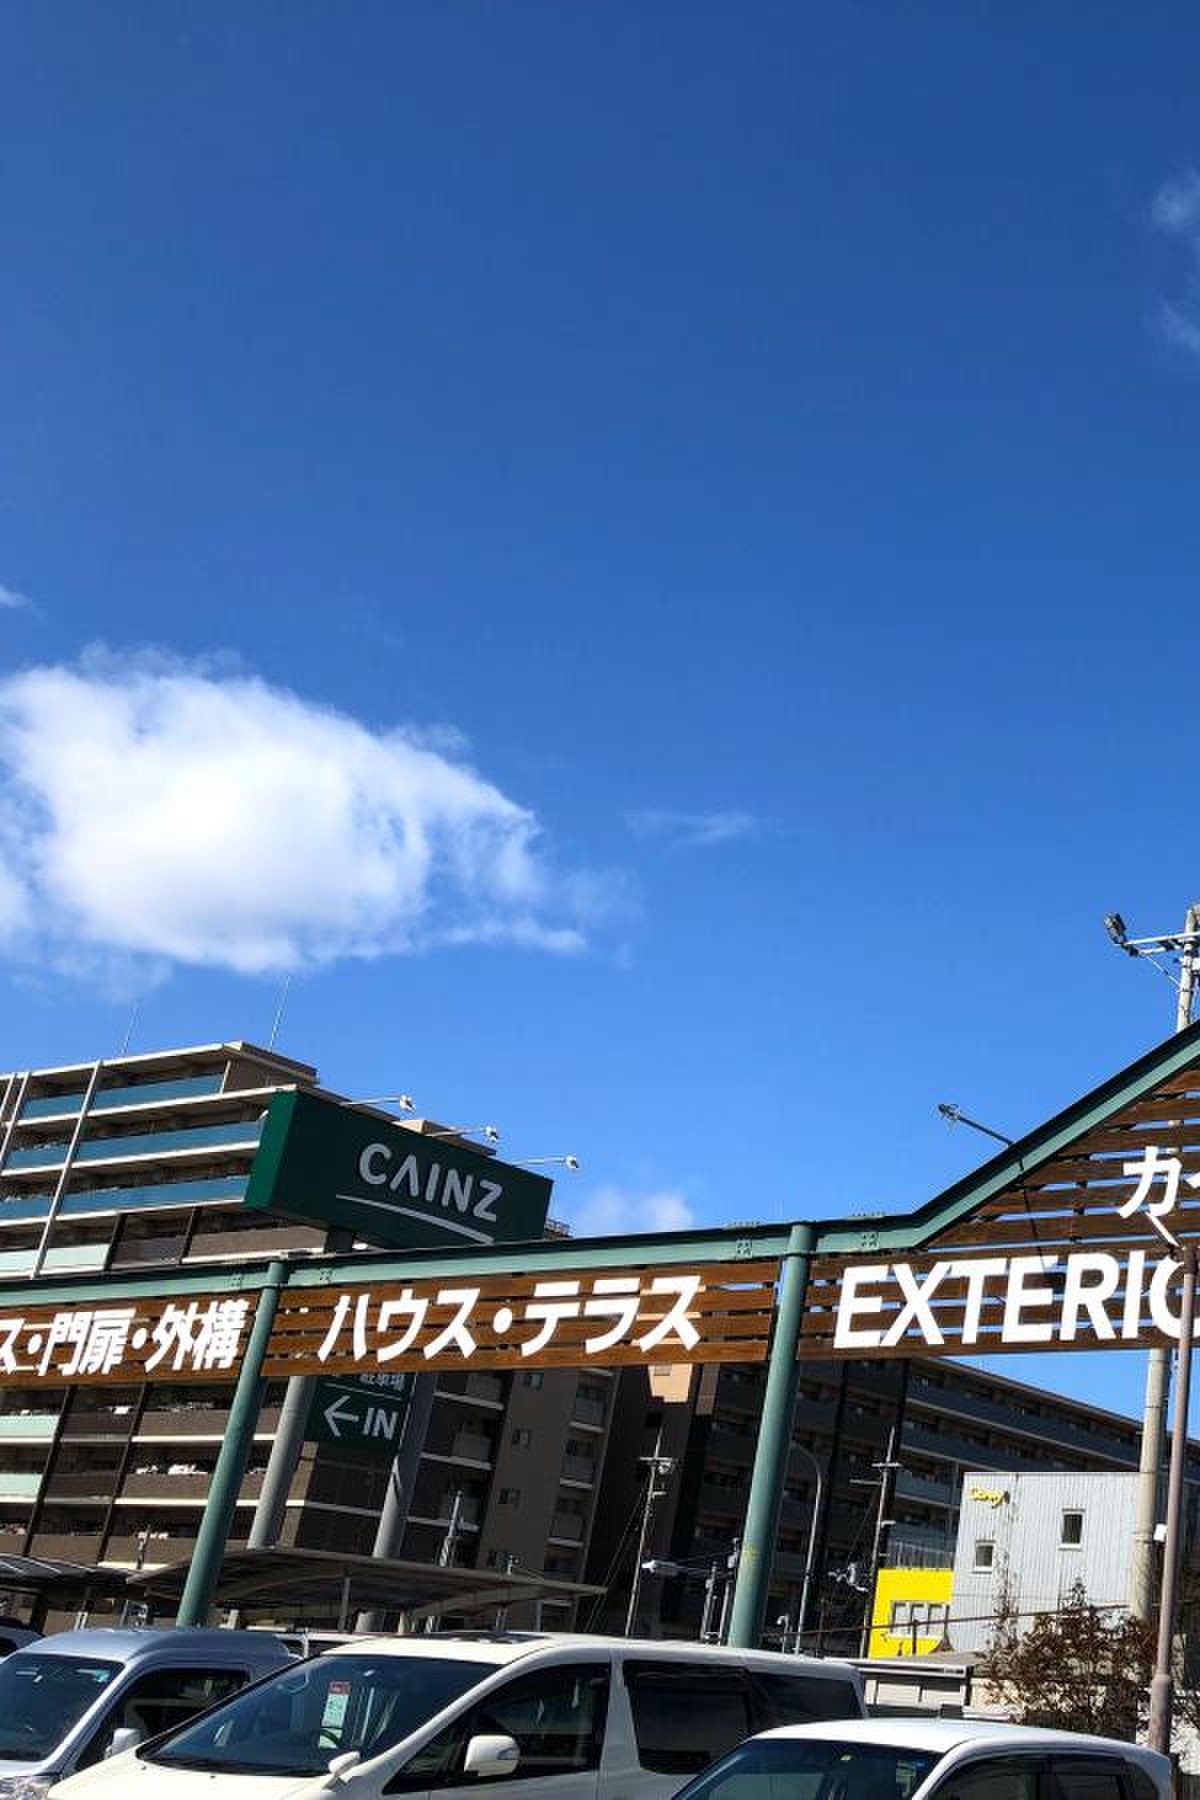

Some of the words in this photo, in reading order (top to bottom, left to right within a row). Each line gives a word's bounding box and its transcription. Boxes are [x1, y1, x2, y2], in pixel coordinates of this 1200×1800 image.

[359, 1143, 503, 1223] CAINZ
[317, 1275, 703, 1363] ハウス・テラス
[361, 1407, 399, 1440] IN
